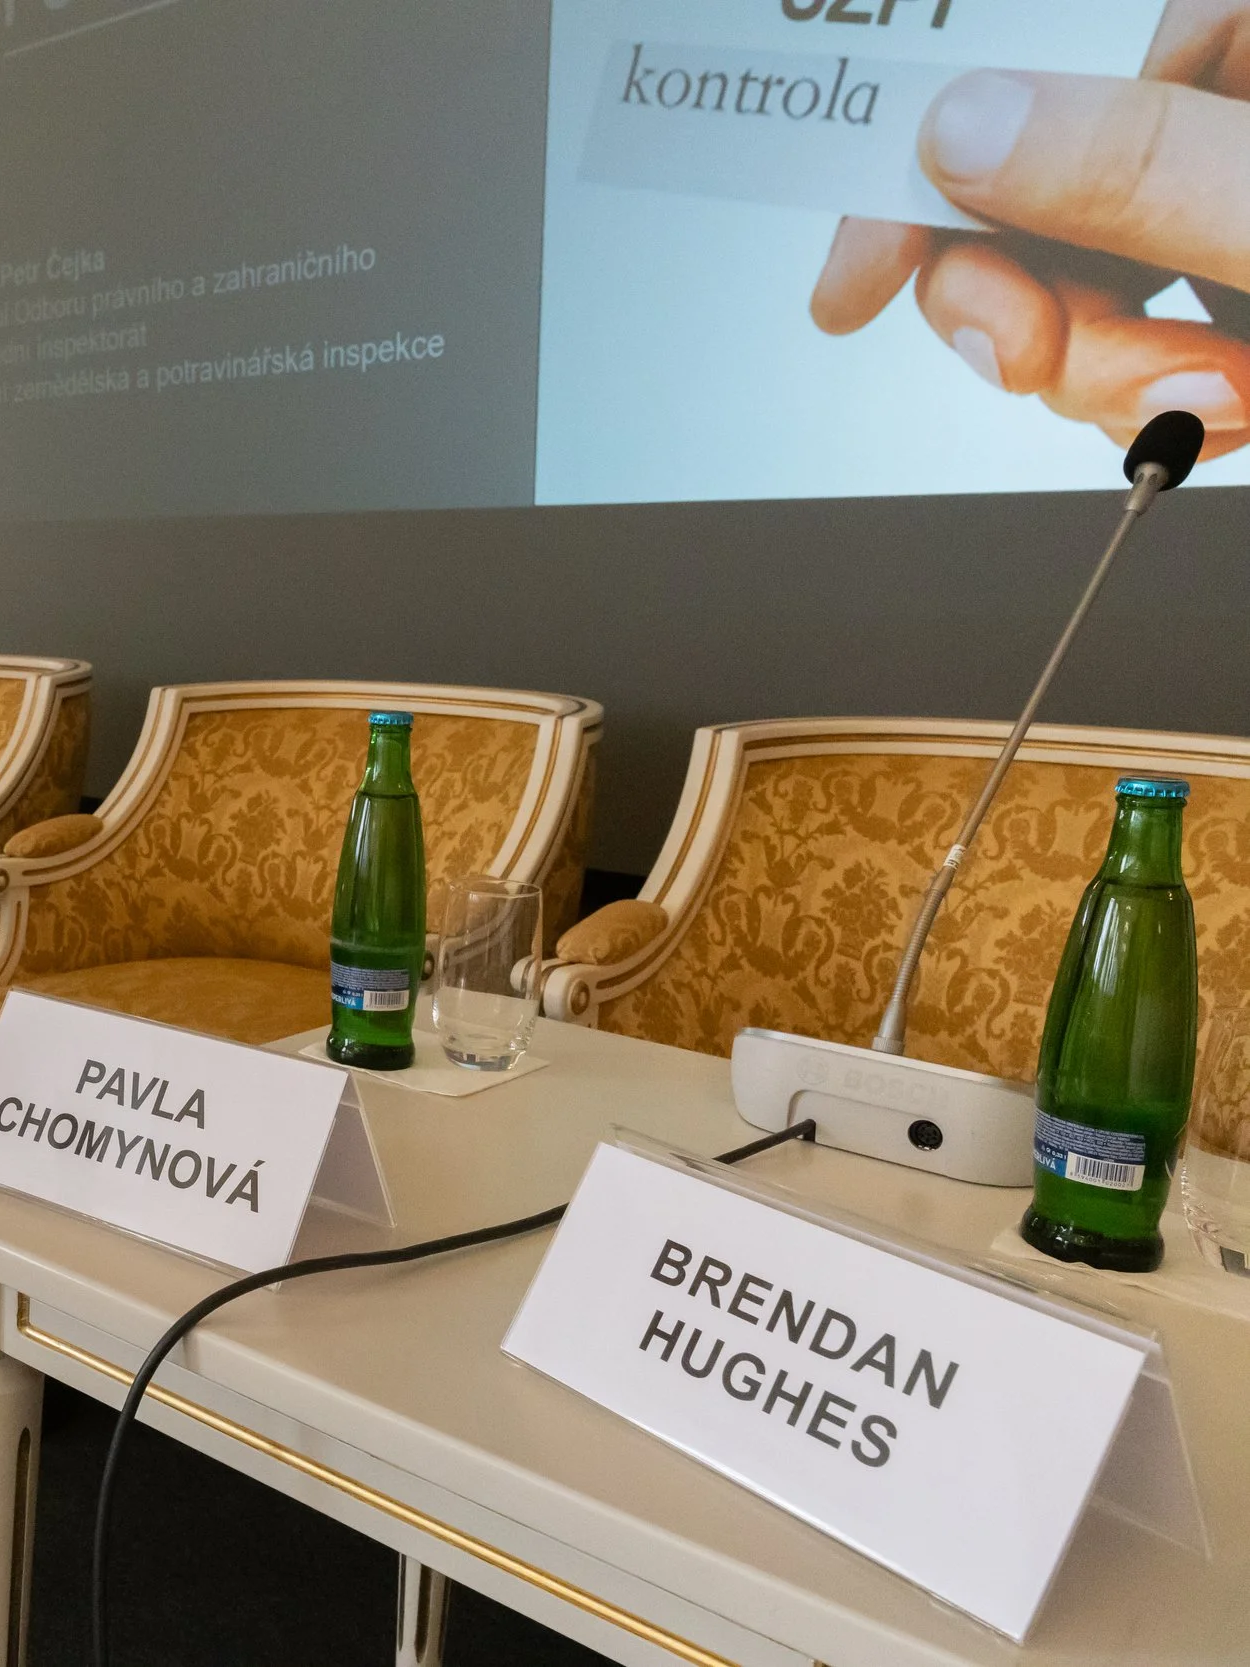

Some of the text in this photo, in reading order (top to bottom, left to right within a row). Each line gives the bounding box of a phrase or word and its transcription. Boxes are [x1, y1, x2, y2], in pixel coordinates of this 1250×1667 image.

[622, 43, 881, 126] kontrola
[14, 295, 87, 324] Odboru
[91, 274, 185, 321] právního
[191, 274, 205, 297] a
[212, 244, 376, 293] zahraničního
[46, 246, 106, 282] Čejka
[136, 368, 150, 390] a
[156, 344, 314, 392] potravinářská
[323, 330, 447, 371] inspekce
[75, 1058, 207, 1130] PAVLA
[648, 1238, 961, 1411] BRENDAN
[638, 1309, 900, 1469] HUGHES
